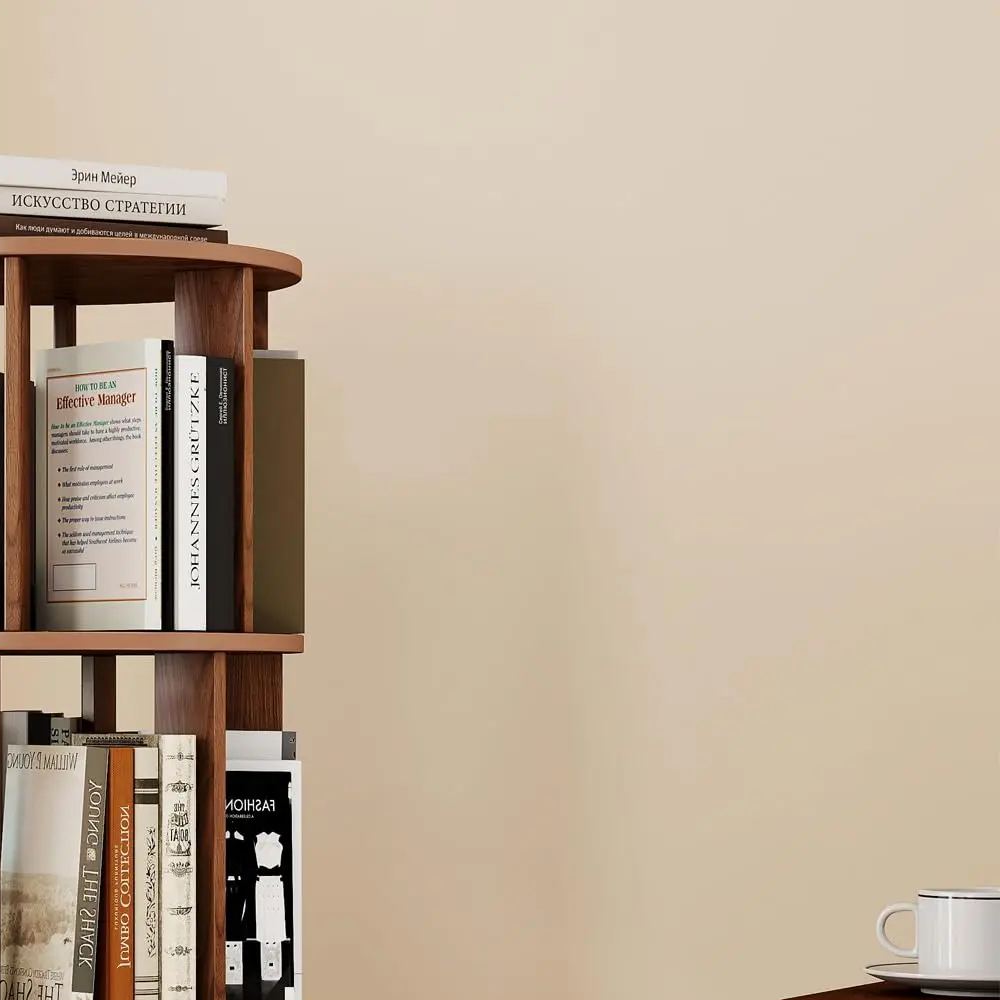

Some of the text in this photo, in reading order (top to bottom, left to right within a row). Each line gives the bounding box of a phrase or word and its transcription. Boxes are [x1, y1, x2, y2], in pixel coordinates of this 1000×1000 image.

[71, 168, 137, 188] Эрин Мейер
[11, 194, 186, 215] ИСКУССТВО СТРАТЕГИИ
[45, 226, 70, 234] думают
[76, 227, 114, 236] добиваются
[75, 380, 117, 392] HOW TO BE AN
[56, 391, 137, 410] Effective Manager
[188, 372, 201, 590] JOHANNES GRÜTZKE
